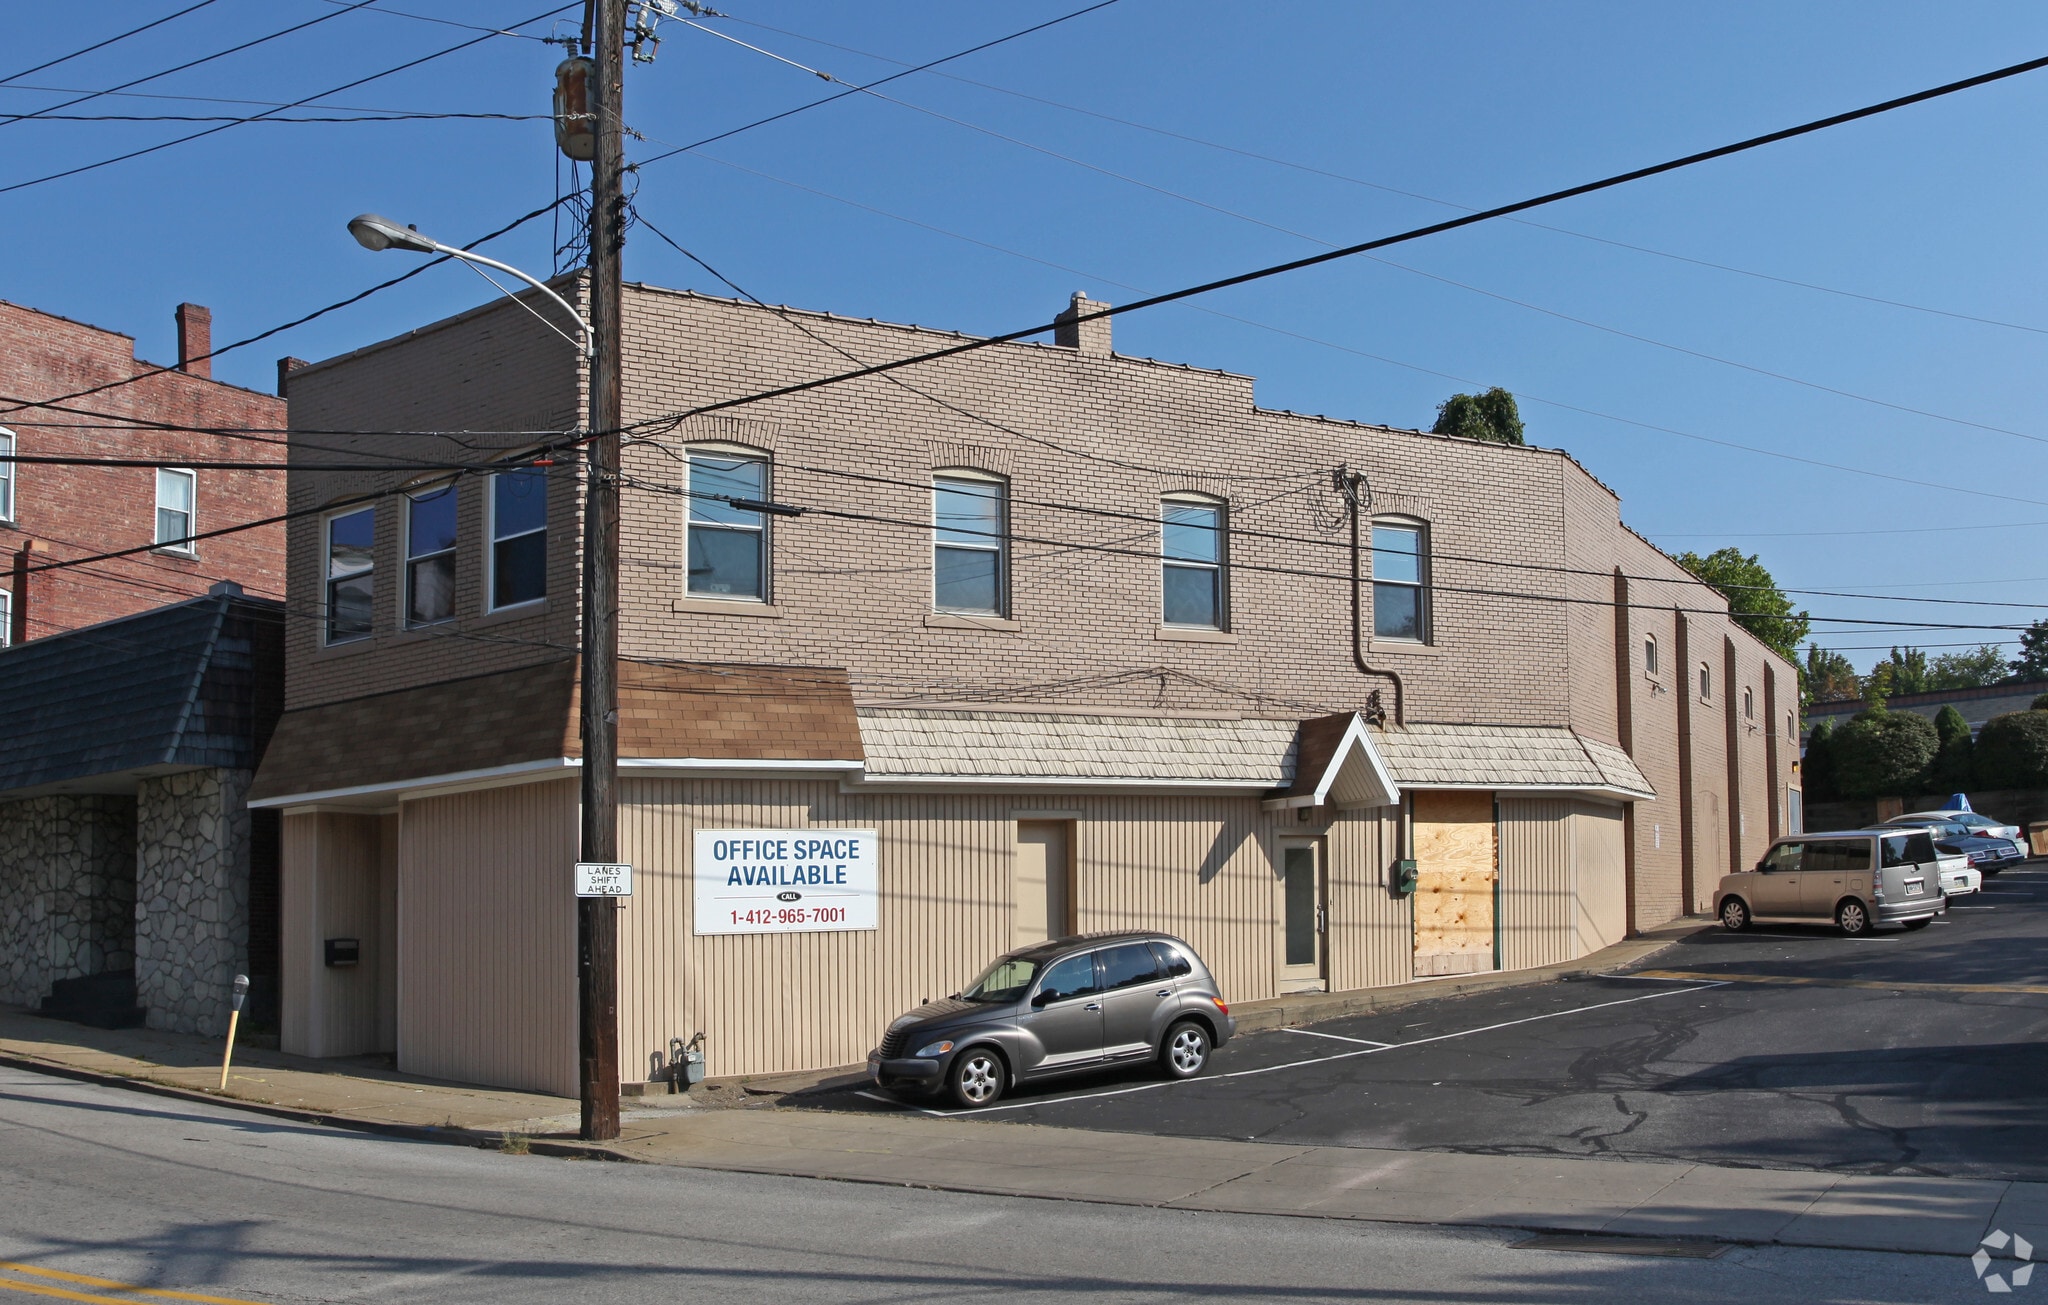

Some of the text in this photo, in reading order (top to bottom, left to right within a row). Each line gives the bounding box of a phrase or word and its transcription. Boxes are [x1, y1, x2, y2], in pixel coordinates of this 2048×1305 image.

[713, 839, 860, 861] OFFICE SPACE
[587, 866, 621, 875] LANES
[727, 865, 847, 886] AVAILABLE
[591, 876, 618, 884] SHIFT
[587, 885, 622, 893] AHEAD
[730, 908, 845, 925] 1-412-965-7001
